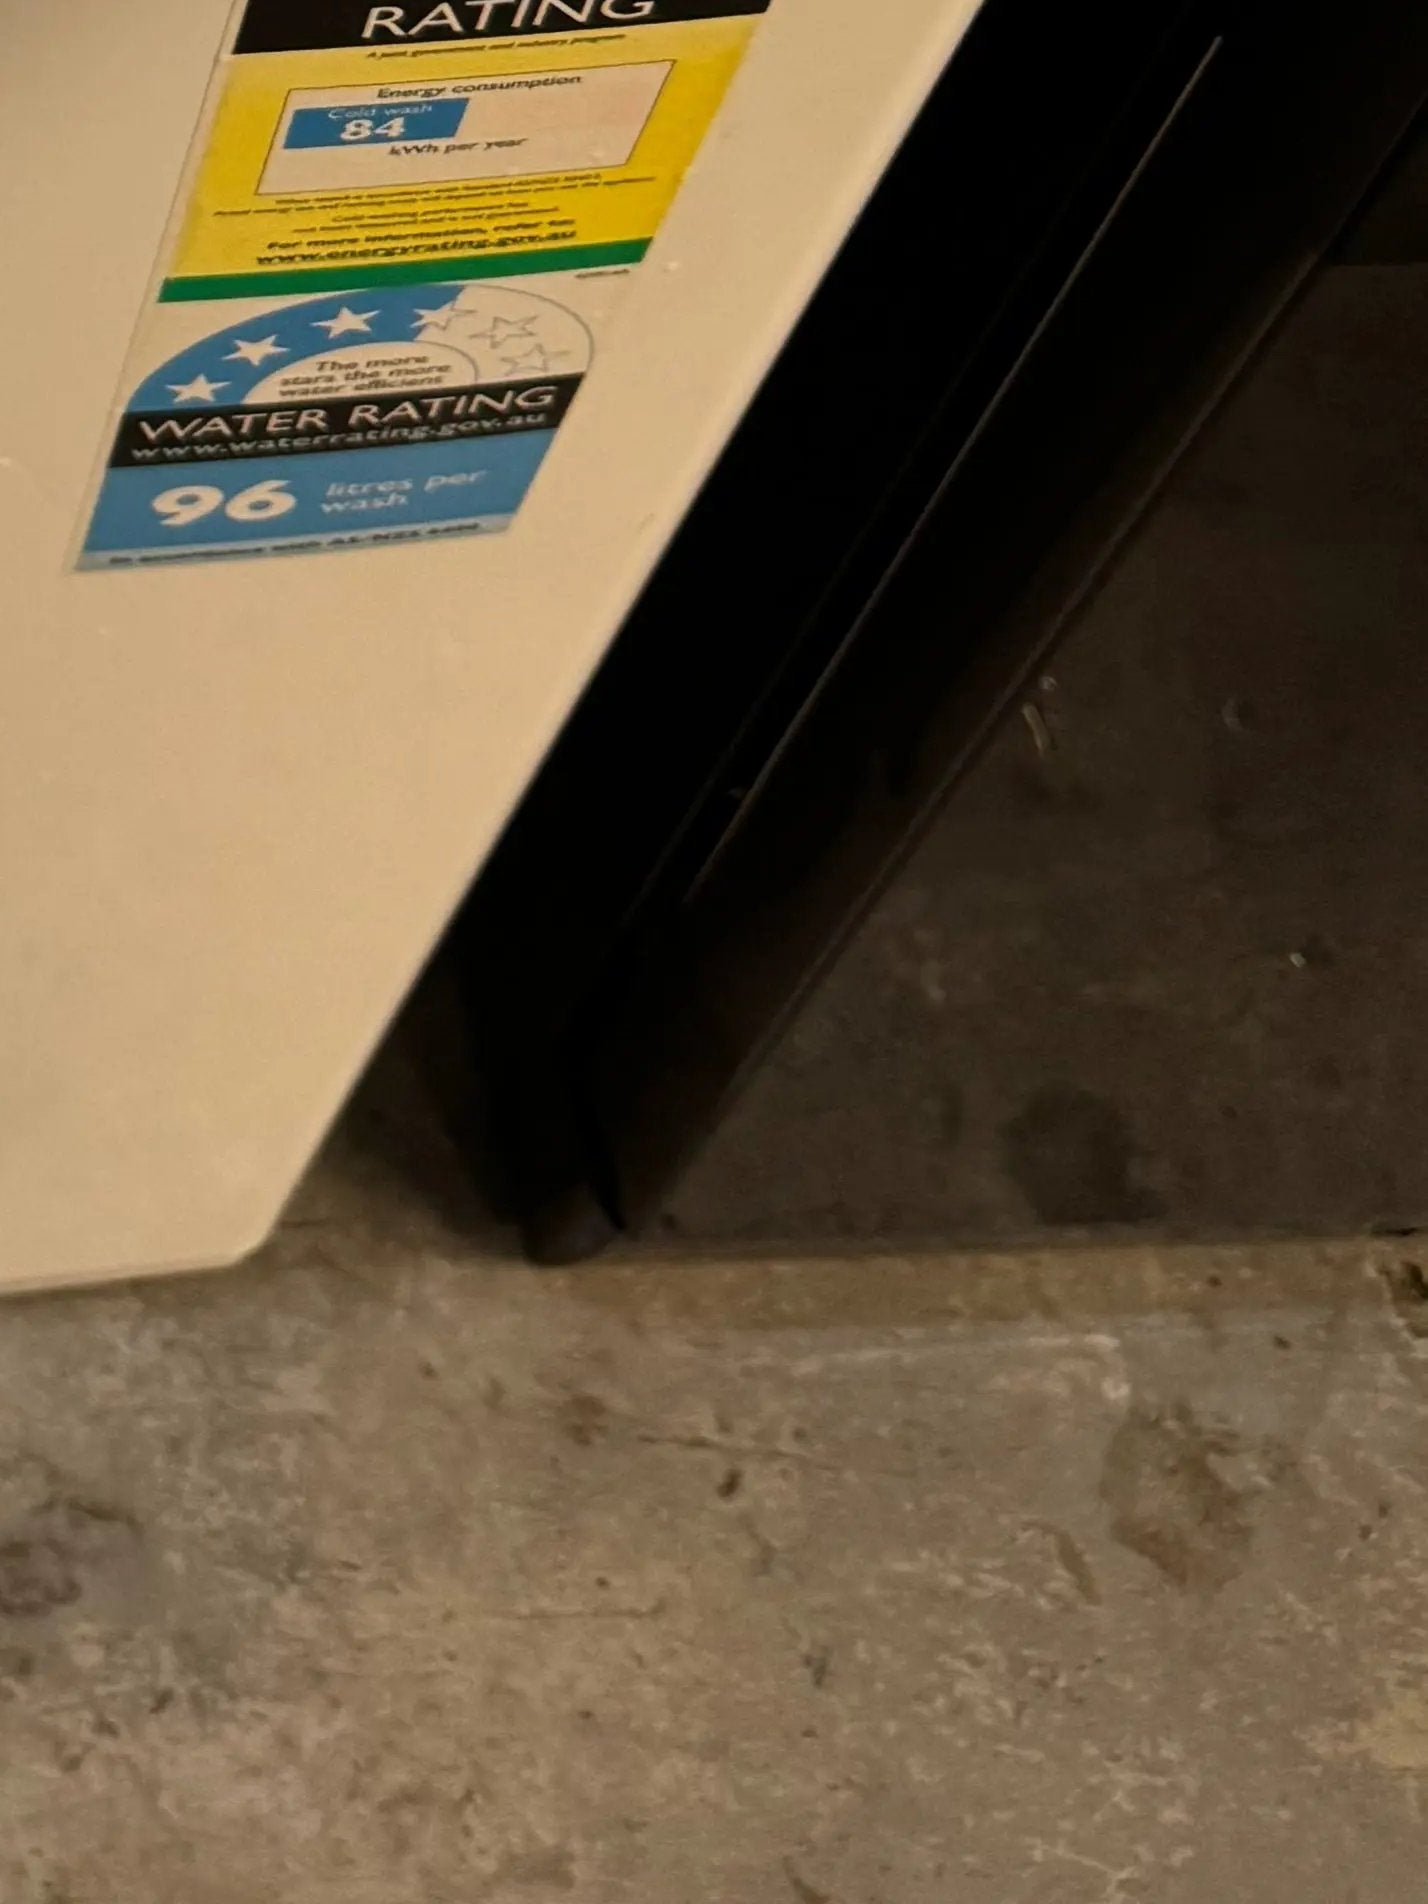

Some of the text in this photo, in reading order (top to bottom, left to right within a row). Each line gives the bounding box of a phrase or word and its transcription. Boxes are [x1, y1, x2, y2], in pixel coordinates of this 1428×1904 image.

[377, 76, 583, 101] Energy consumption
[328, 104, 433, 120] Cold wash
[340, 116, 405, 141] 84
[445, 140, 478, 155] per
[483, 137, 527, 151] year
[280, 364, 451, 387] stars the more
[316, 356, 429, 372] The more
[280, 385, 342, 397] water
[139, 386, 559, 444] WATER RATING
[131, 411, 546, 461] www.waterrating.gov.au
[151, 468, 487, 527] 96 litres per
[320, 492, 408, 516] wash
